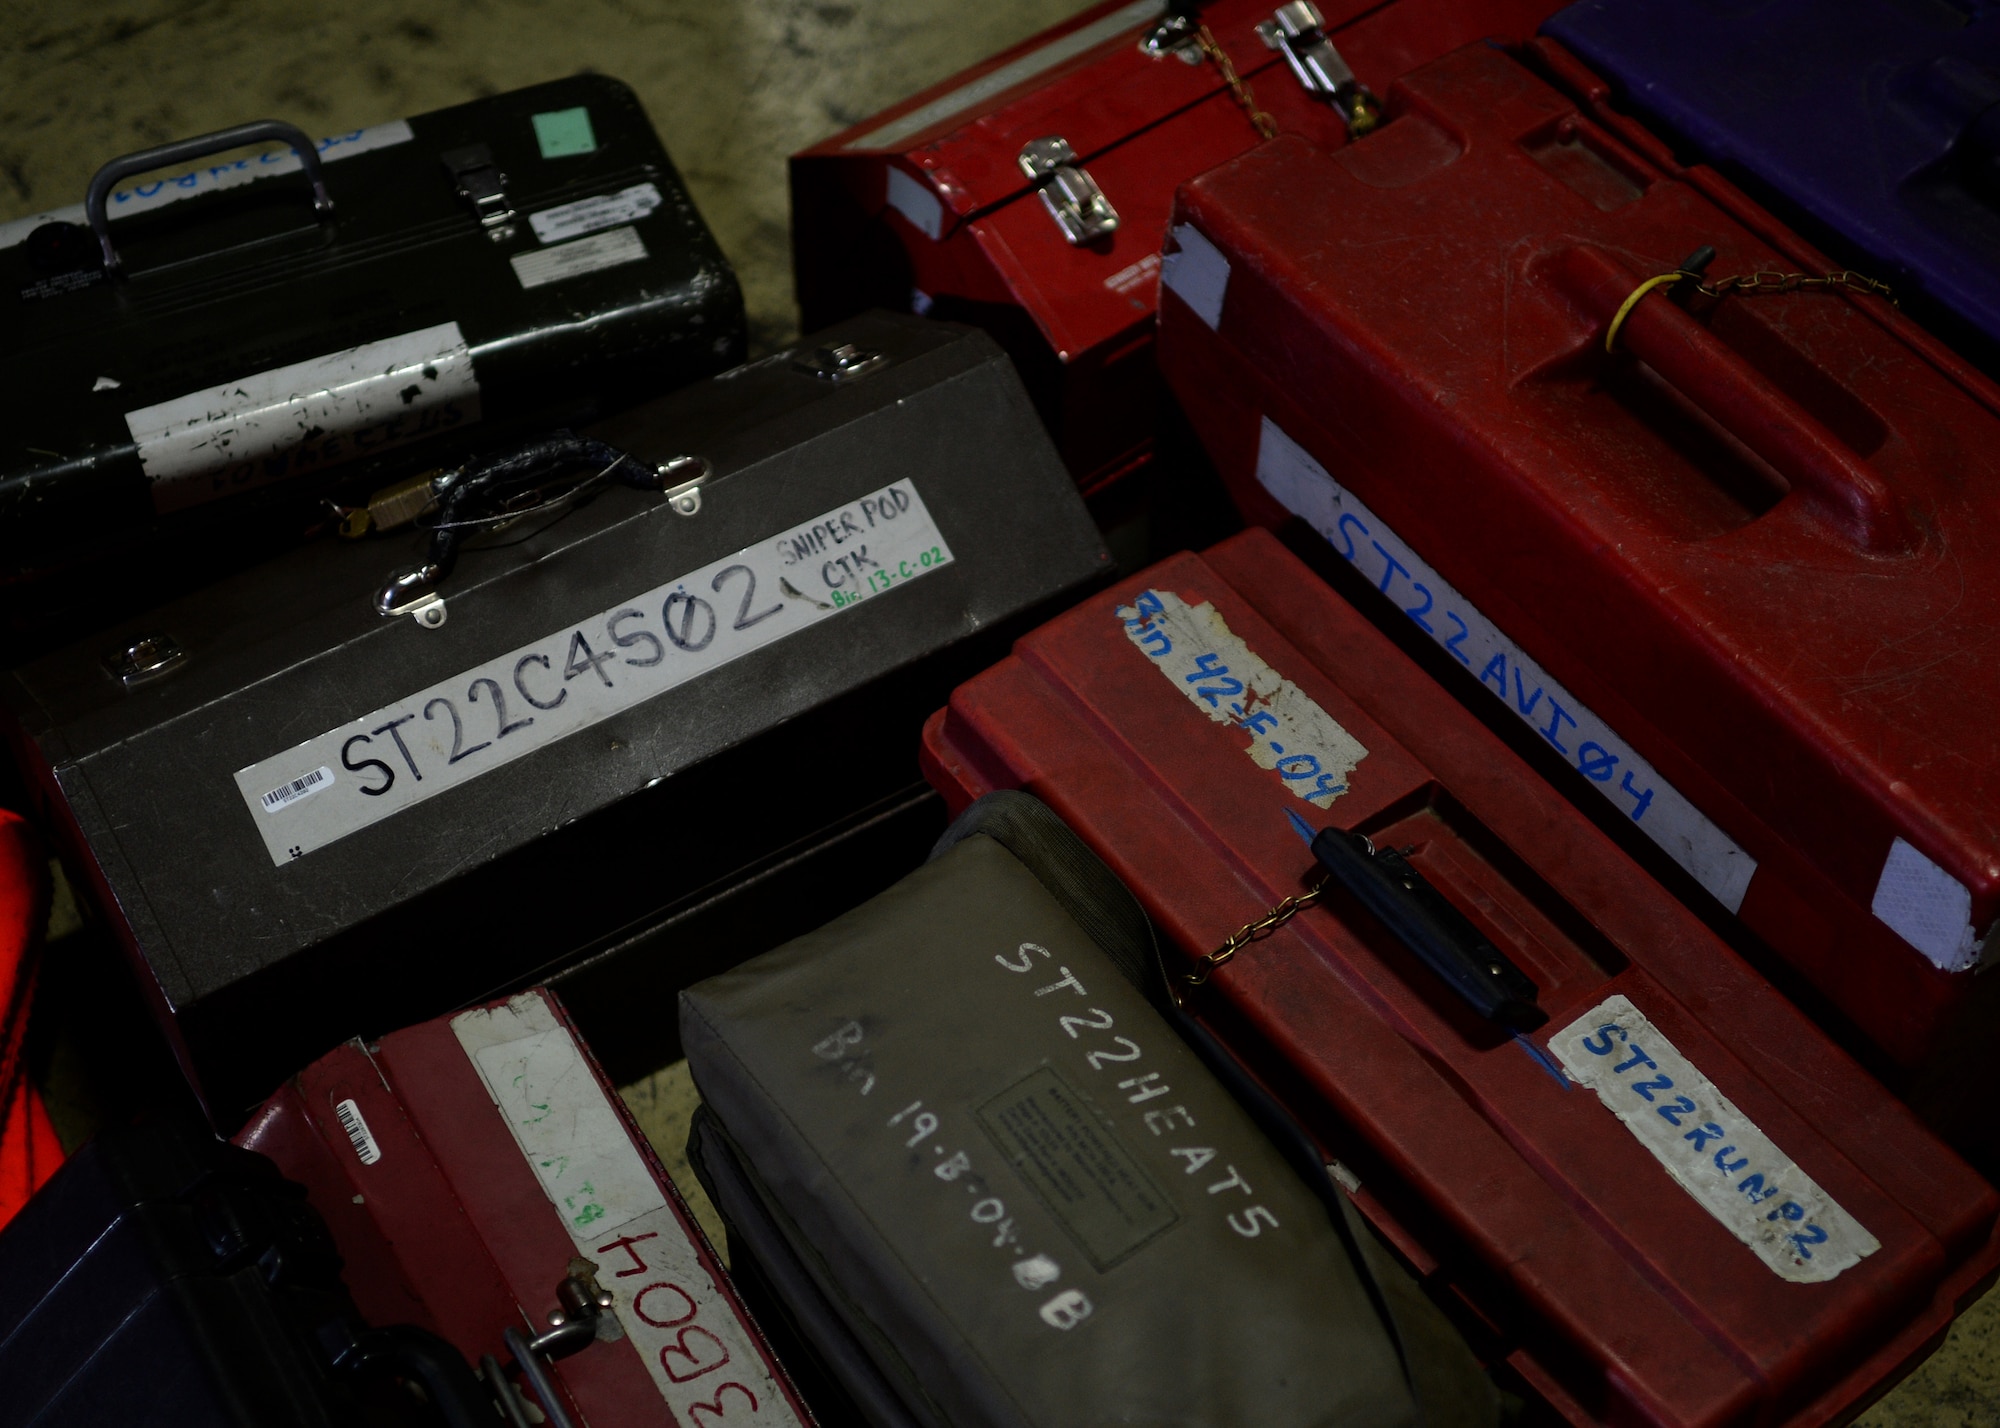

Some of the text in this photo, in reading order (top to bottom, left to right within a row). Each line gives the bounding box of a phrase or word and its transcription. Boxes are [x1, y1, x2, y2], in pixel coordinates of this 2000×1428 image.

[776, 487, 910, 565] SNIPER POD
[822, 544, 880, 588] CTK
[868, 546, 946, 592] 13-C-02
[341, 564, 784, 796] ST22C4S02
[1185, 652, 1346, 801] 42-F-04
[1328, 512, 1655, 821] ST22AVI04
[1582, 1023, 1829, 1260] ST22RUNP2
